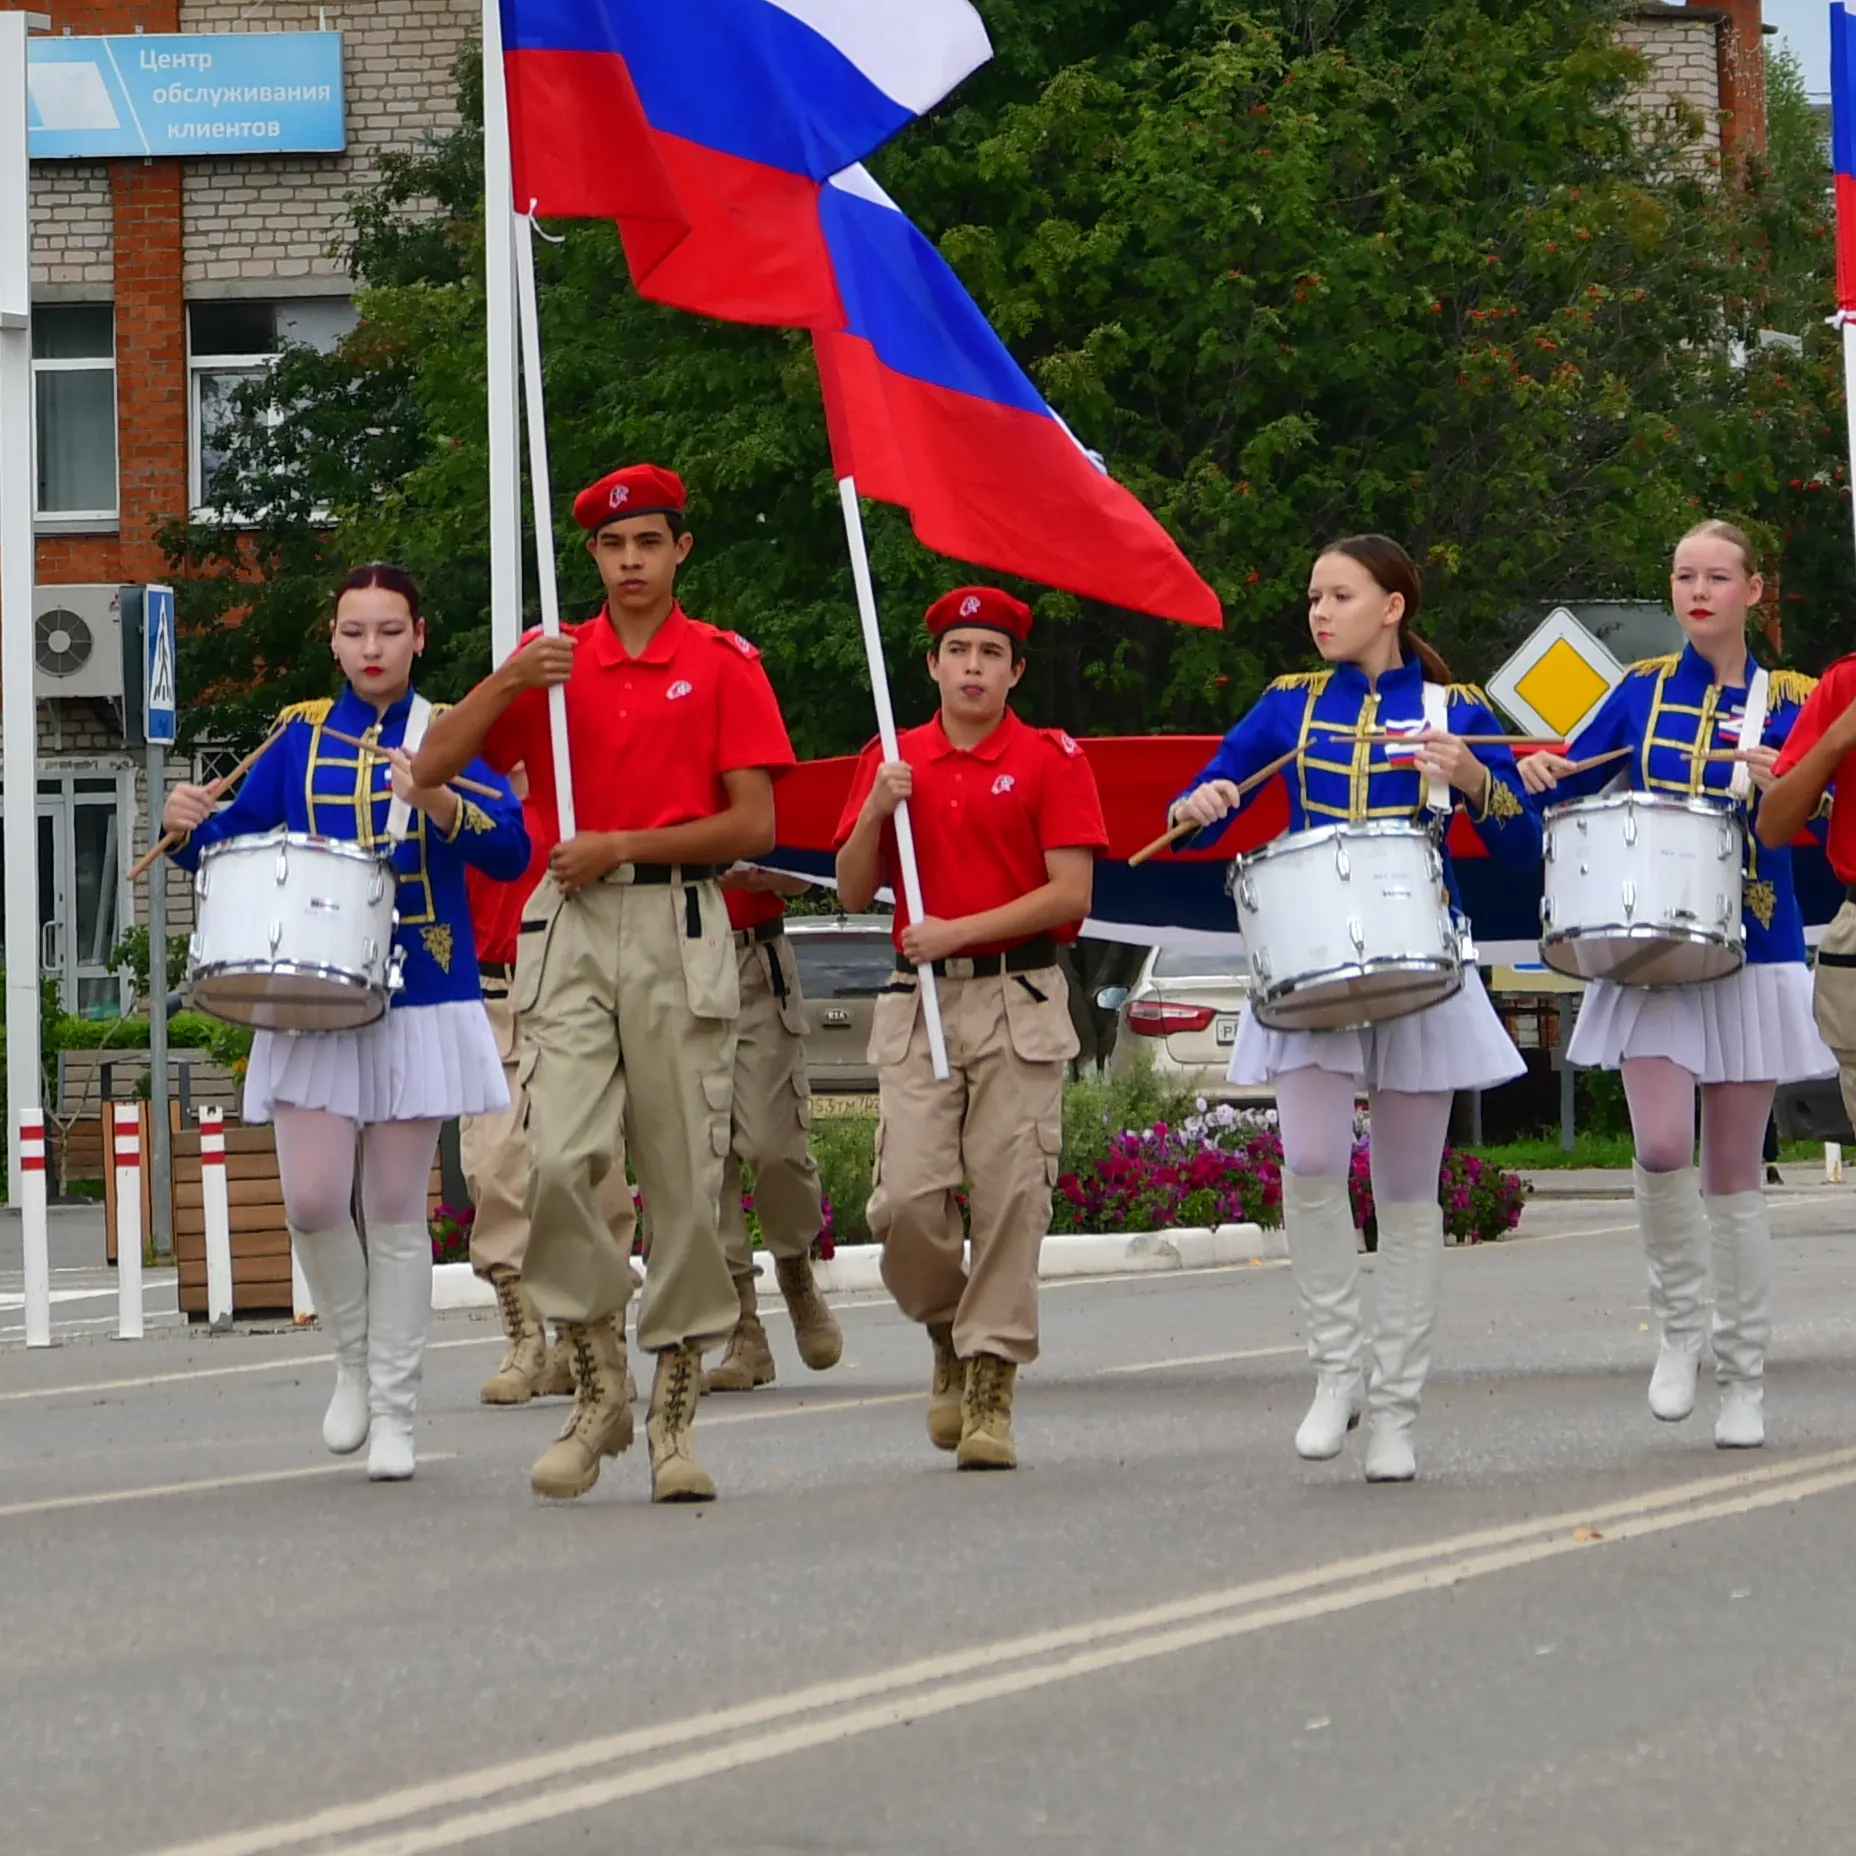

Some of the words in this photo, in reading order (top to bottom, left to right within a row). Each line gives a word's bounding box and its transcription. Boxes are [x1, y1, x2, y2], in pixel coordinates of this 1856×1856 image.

[139, 49, 213, 73] Центр
[152, 82, 331, 108] обслуживания
[167, 120, 281, 139] клиентов
